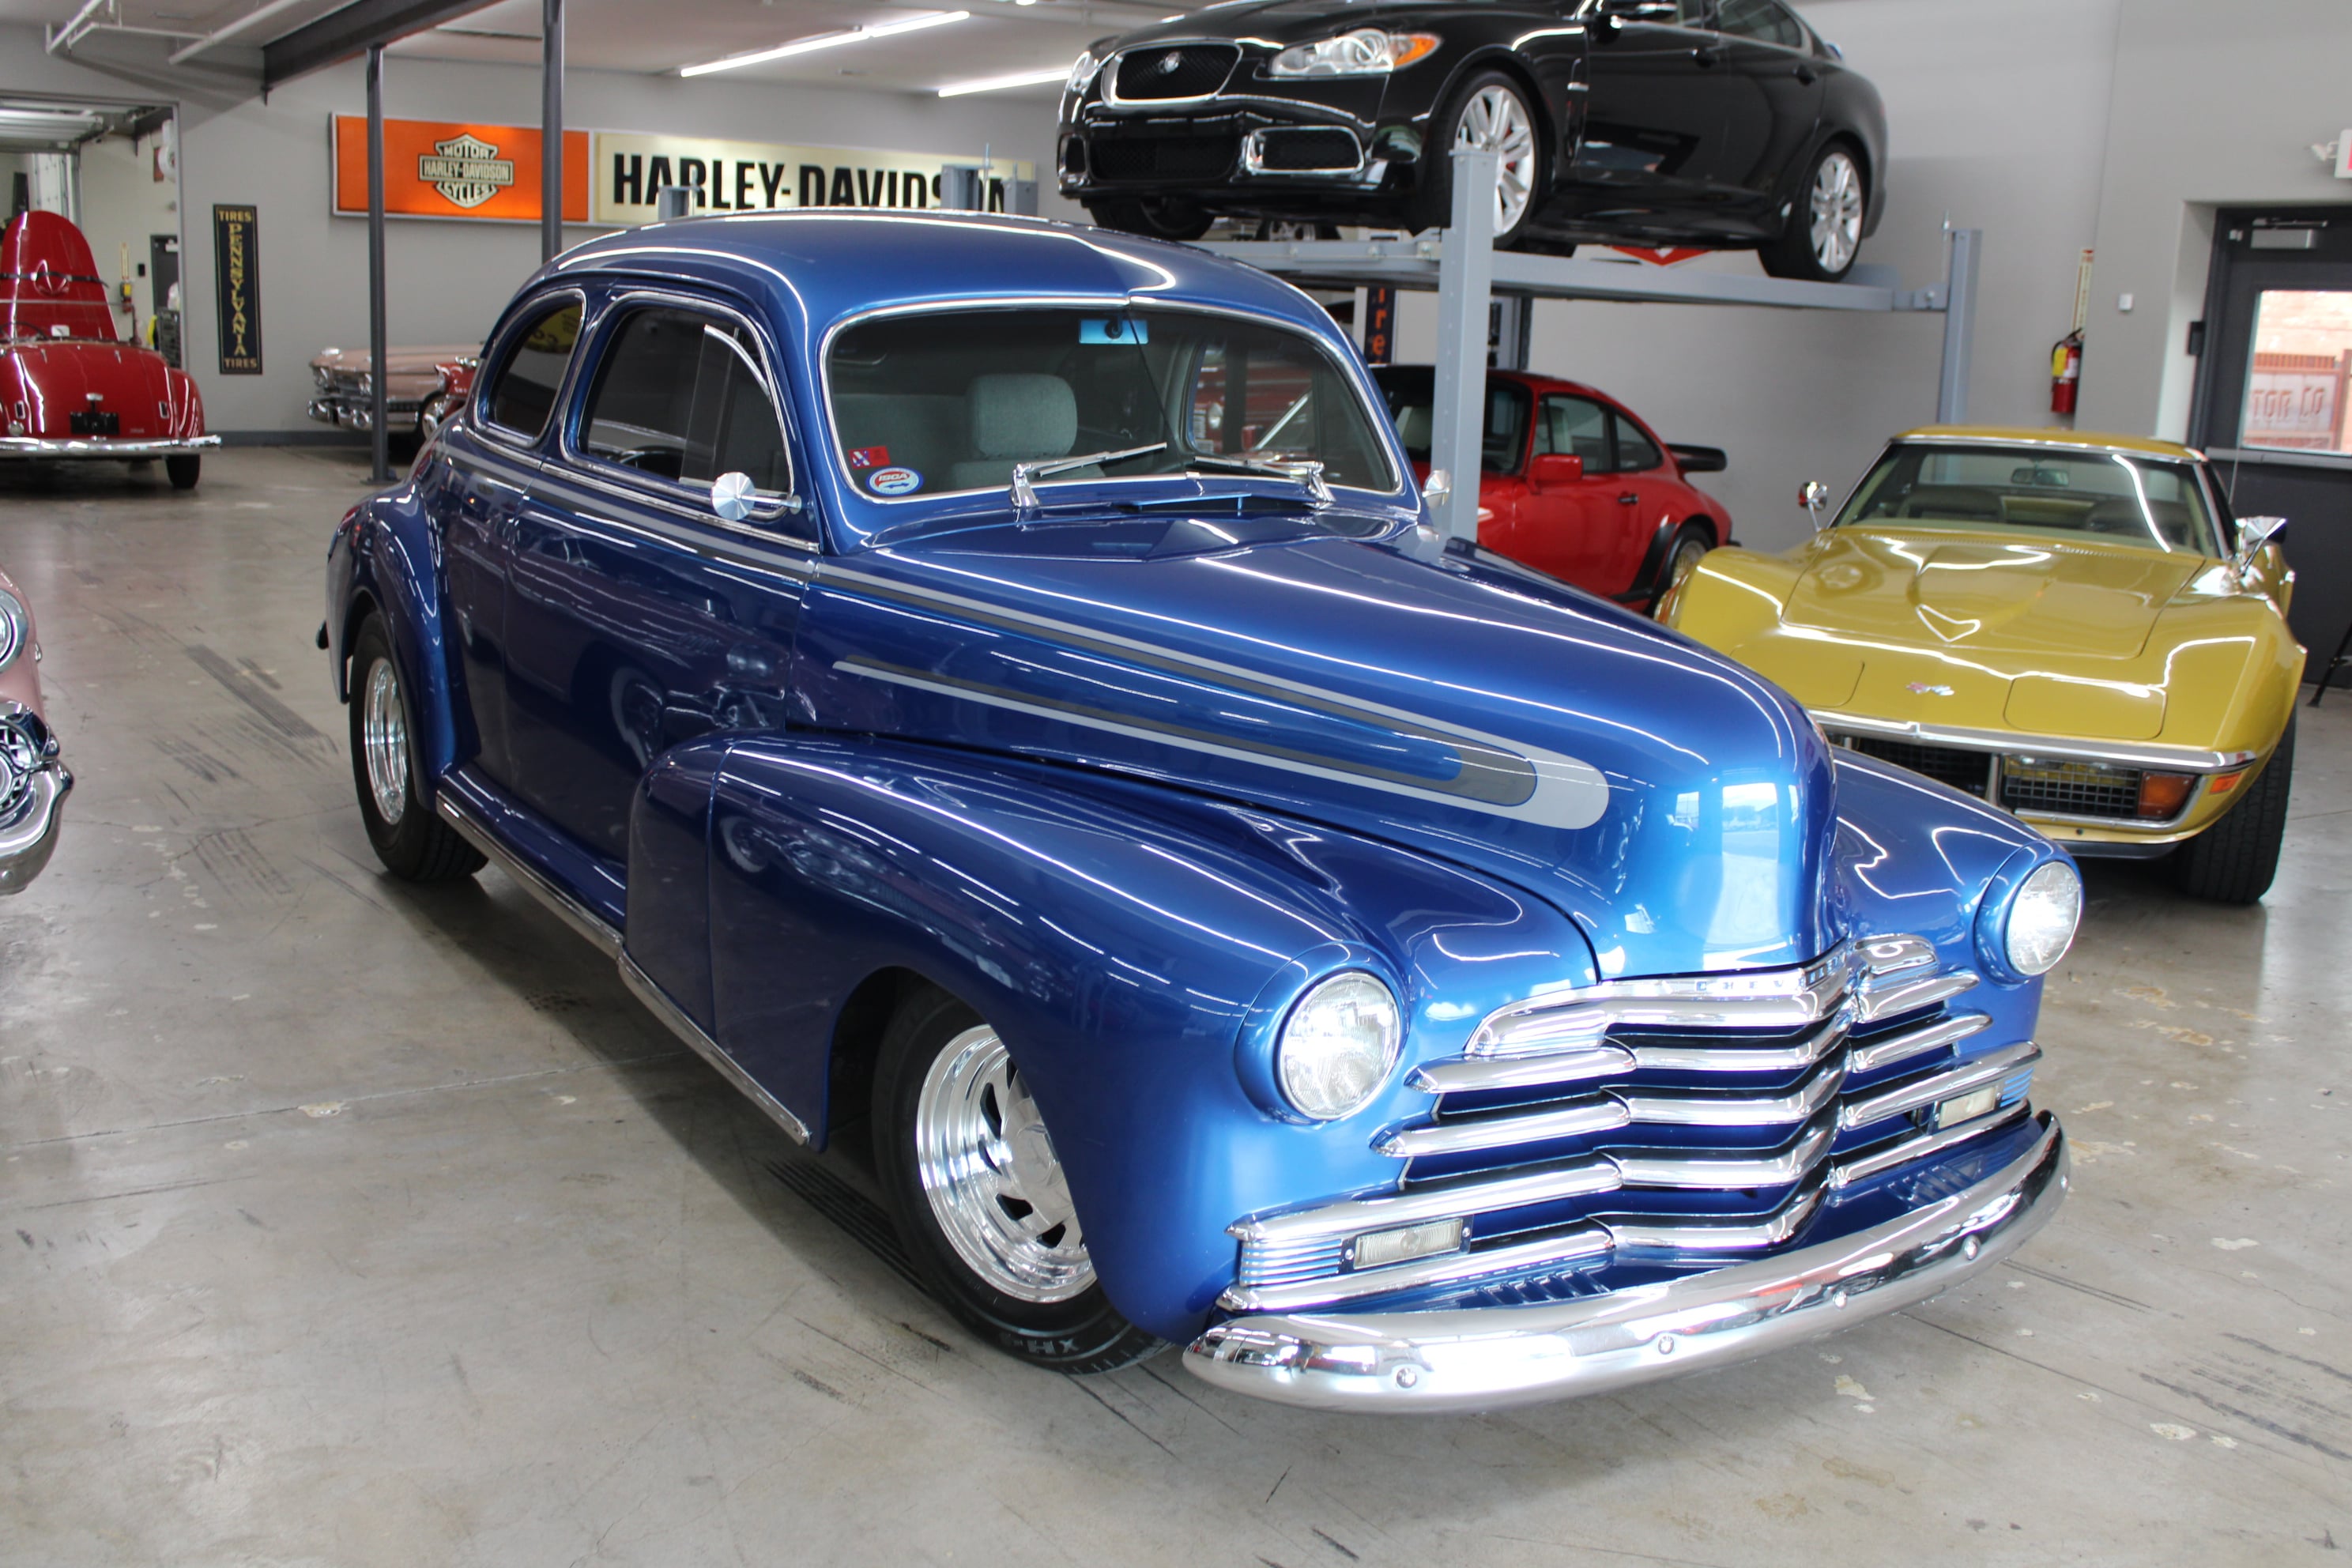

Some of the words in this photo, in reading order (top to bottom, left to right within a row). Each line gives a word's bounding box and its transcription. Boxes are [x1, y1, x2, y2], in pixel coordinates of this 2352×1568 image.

[443, 141, 490, 160] MOTOR
[424, 159, 510, 181] HARLEY-DAVIDSON
[443, 182, 490, 203] CYCLES
[219, 210, 252, 221] TIRES
[228, 223, 247, 356] PENNSYLVANIA
[224, 358, 257, 369] TIRES
